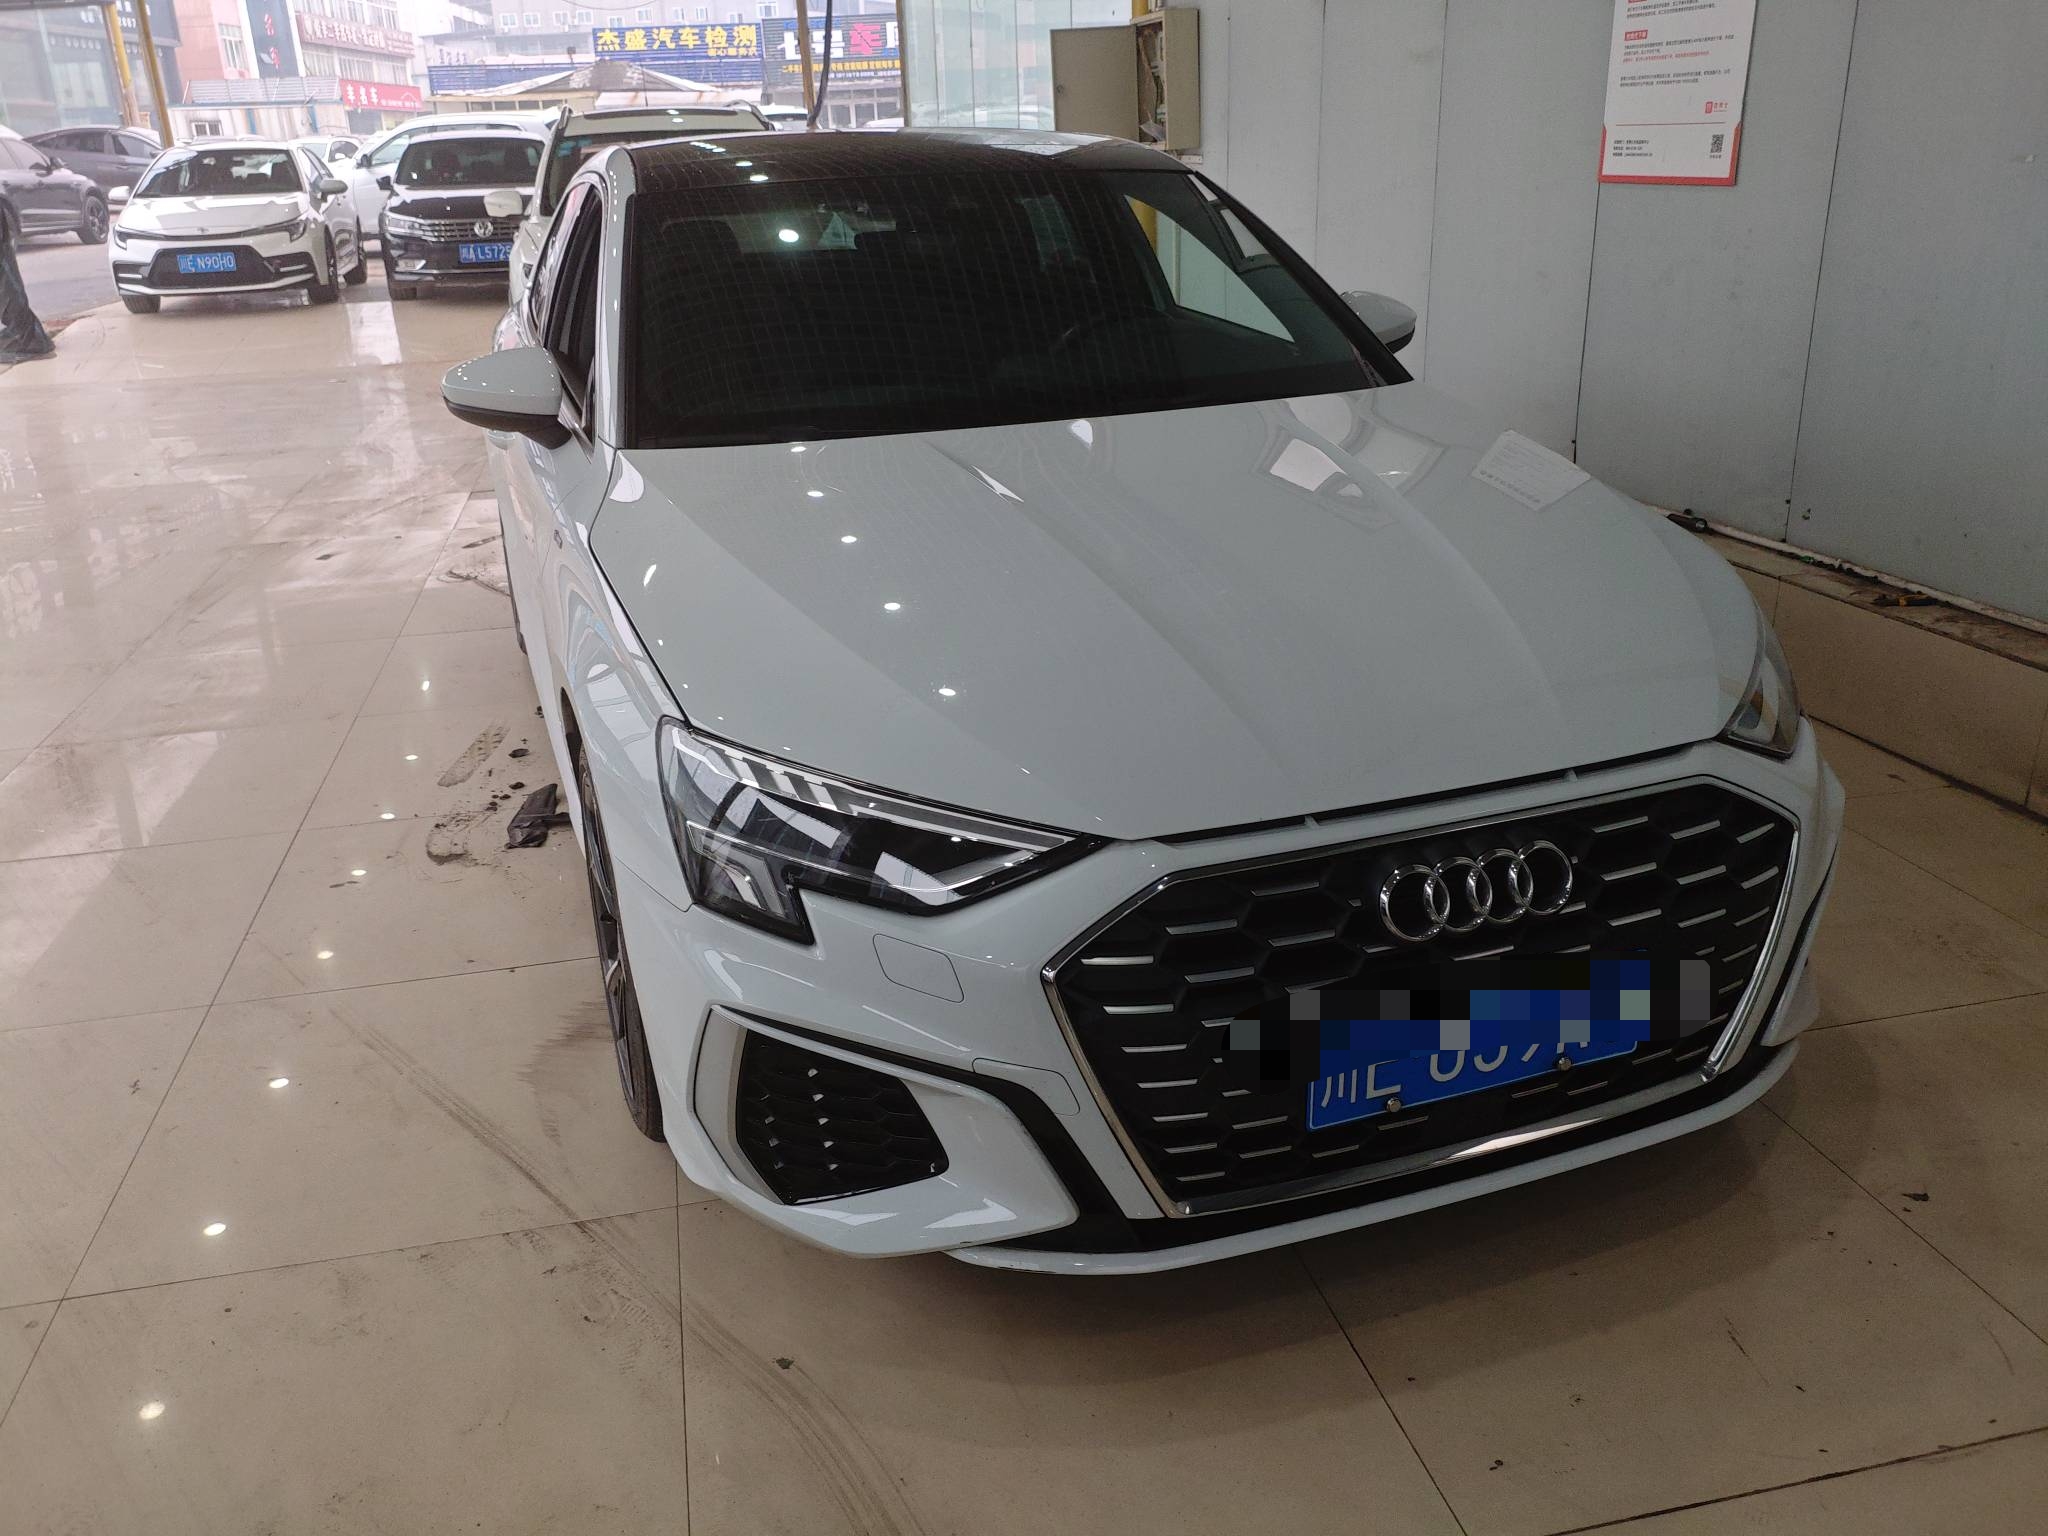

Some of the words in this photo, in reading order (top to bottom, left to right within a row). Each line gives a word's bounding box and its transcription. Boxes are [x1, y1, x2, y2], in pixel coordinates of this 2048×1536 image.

[597, 24, 757, 51] 杰盛汽车检测
[777, 21, 898, 60] 七号车
